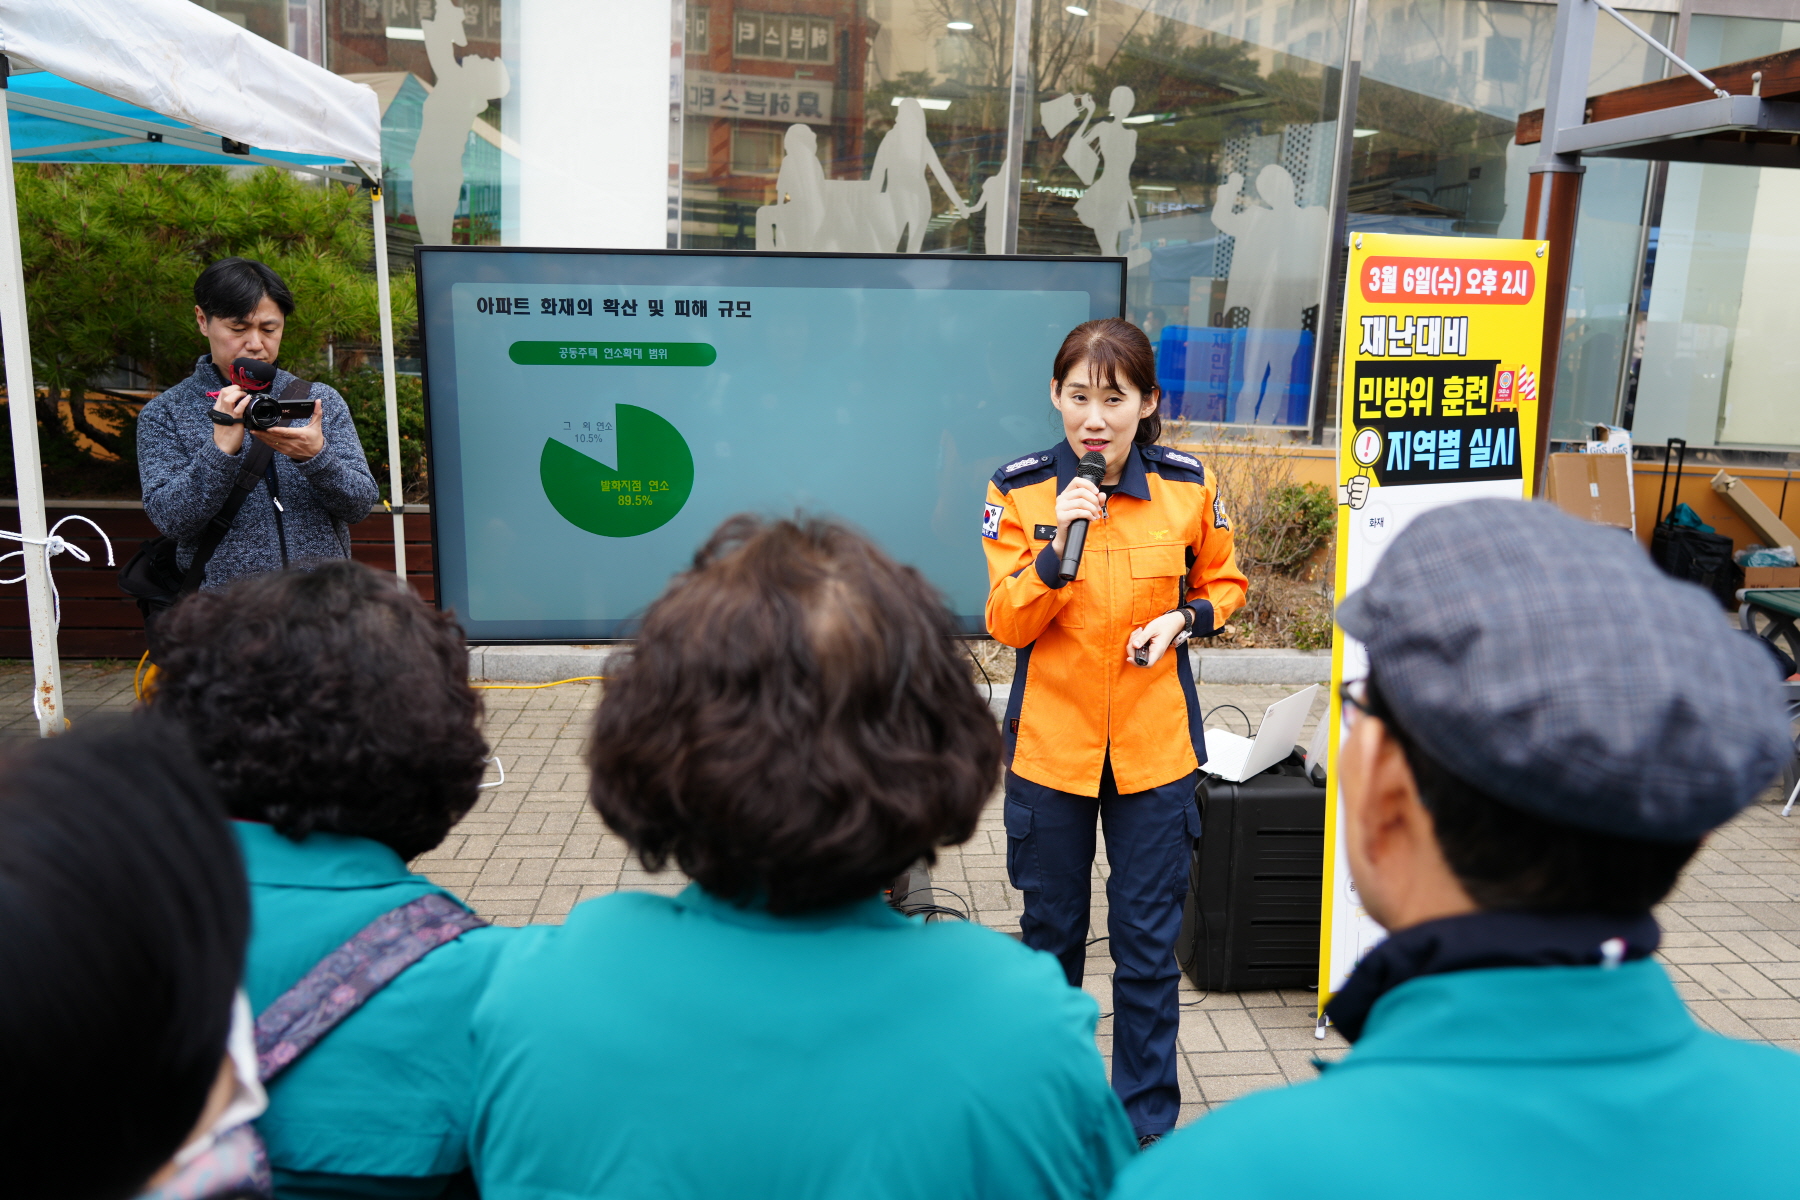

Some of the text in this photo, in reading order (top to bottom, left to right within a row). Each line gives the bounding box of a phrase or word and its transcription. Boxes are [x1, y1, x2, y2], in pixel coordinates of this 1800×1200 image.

[1368, 265, 1528, 297] 3월 6일(수) 오후 2시
[476, 297, 752, 318] 아파트 화재의 확산 및 피해 규모
[1359, 315, 1468, 357] 재난대비
[558, 347, 669, 360] 공동주택 연소확대 범위
[1358, 375, 1489, 419] 민방위 훈련
[563, 421, 572, 431] 그
[596, 421, 613, 432] 연소
[574, 433, 603, 443] 10.5%
[1386, 427, 1516, 471] 지역별 실시
[600, 480, 670, 492] 발화지점 연소
[617, 495, 653, 506] 89.5%
[1368, 517, 1385, 528] 화재
